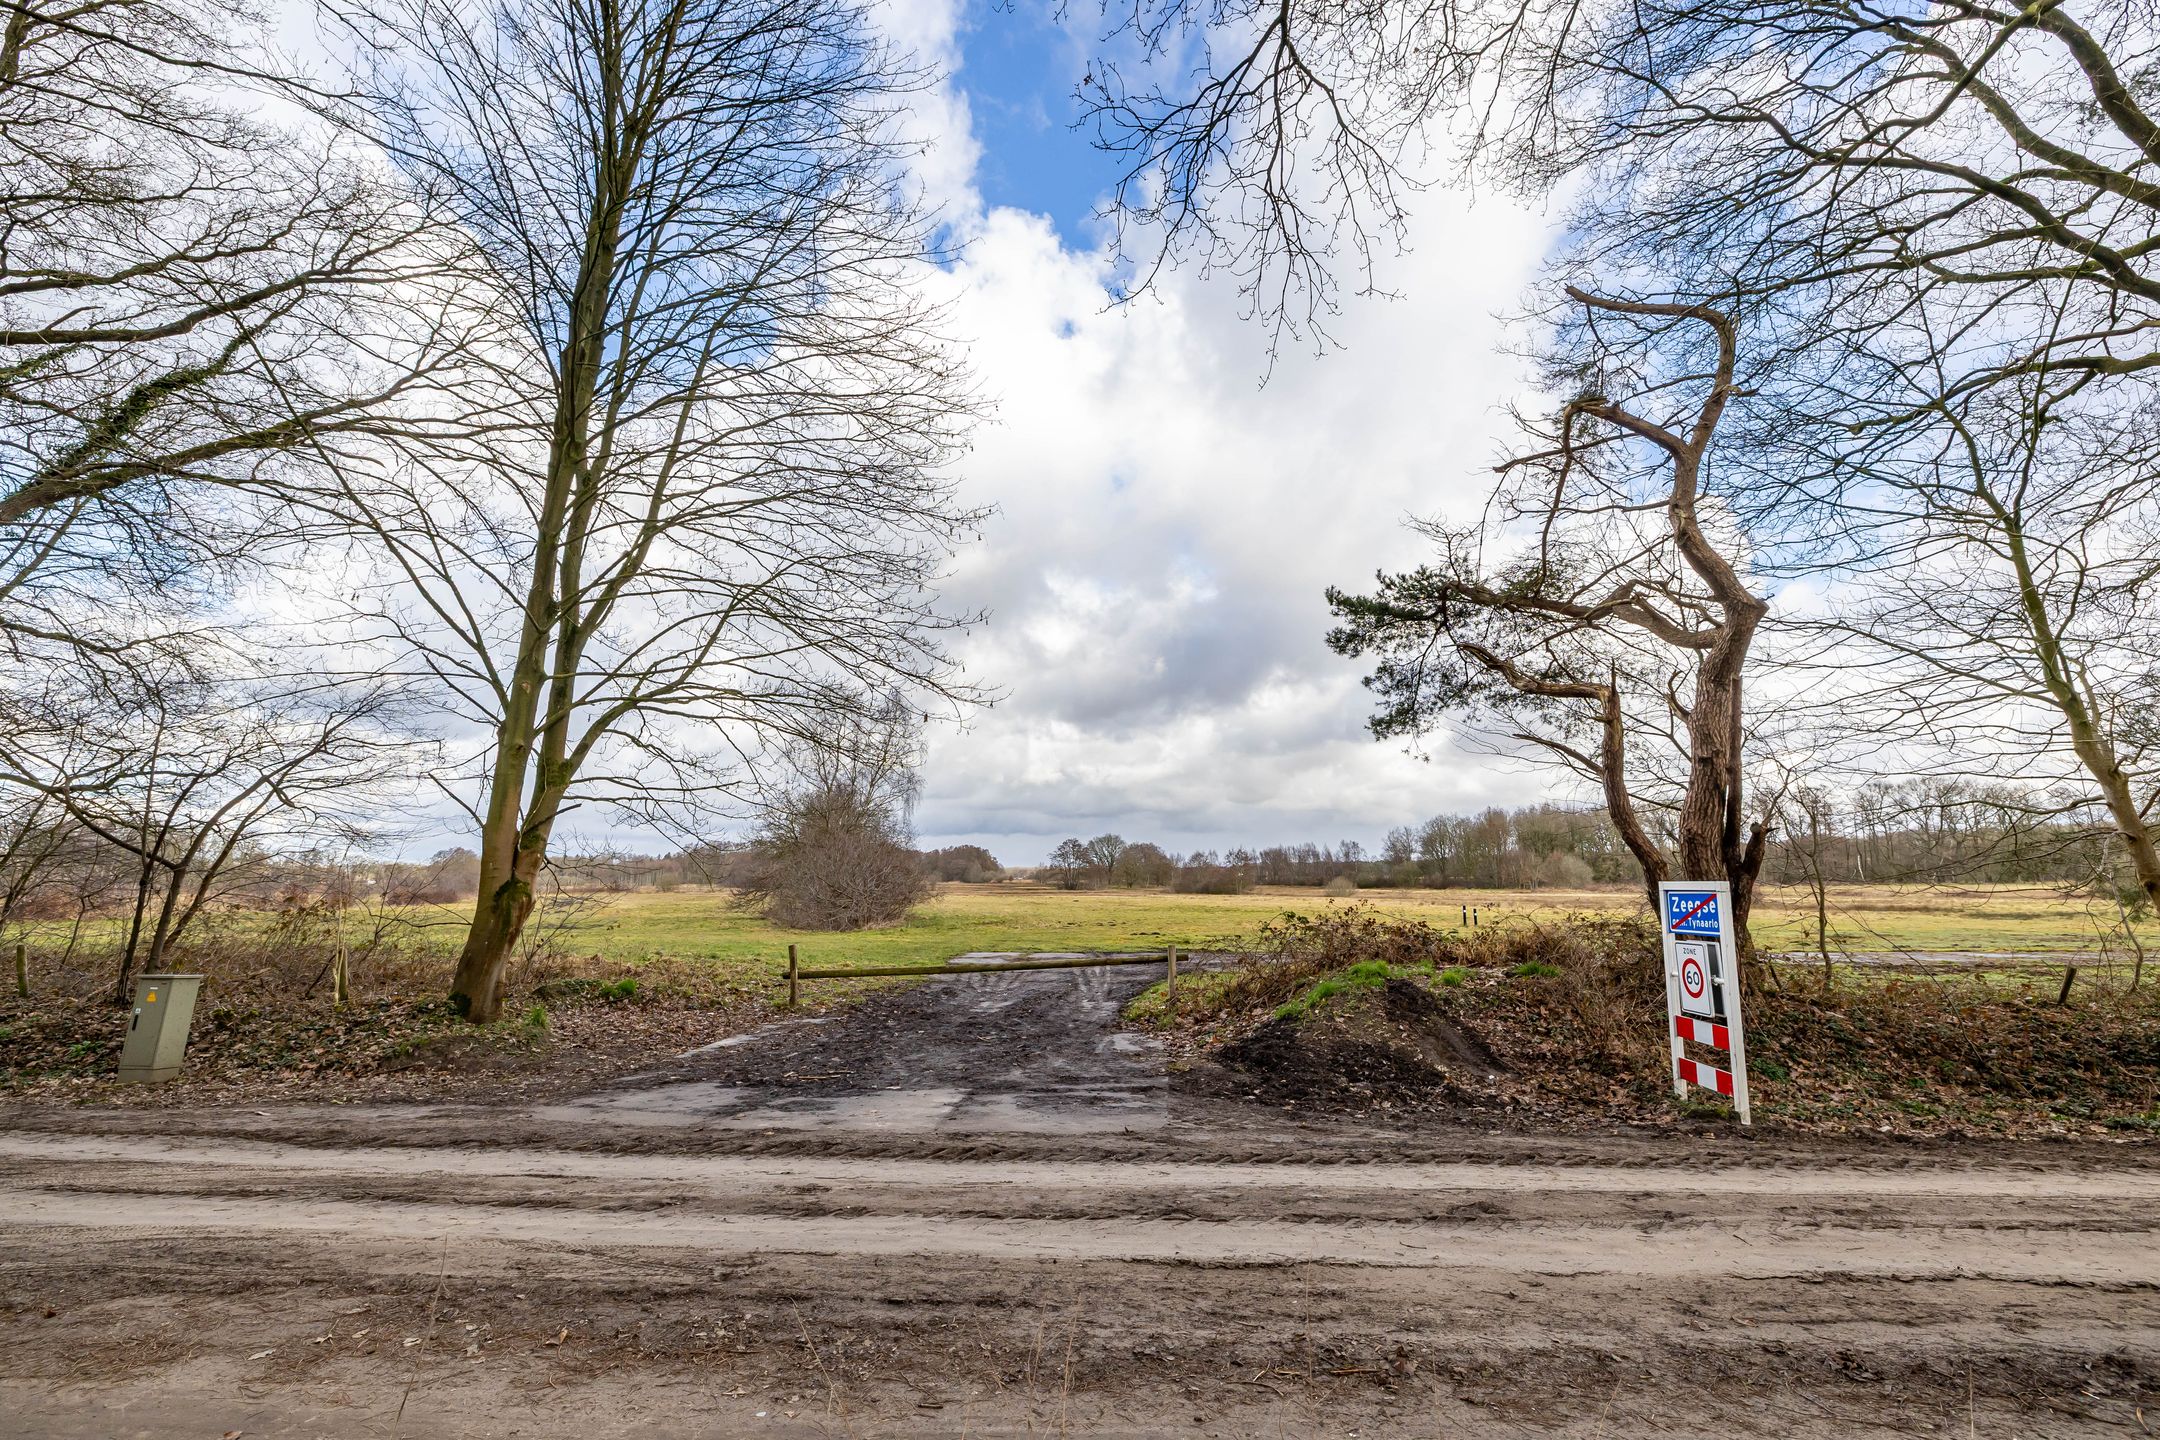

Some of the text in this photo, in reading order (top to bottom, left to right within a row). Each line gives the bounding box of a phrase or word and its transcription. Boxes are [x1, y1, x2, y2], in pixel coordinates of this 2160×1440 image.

[1671, 896, 1716, 918] Zeegse
[1688, 917, 1719, 929] Tynaarlo
[1683, 947, 1697, 956] ZONE
[1686, 970, 1700, 986] 60
